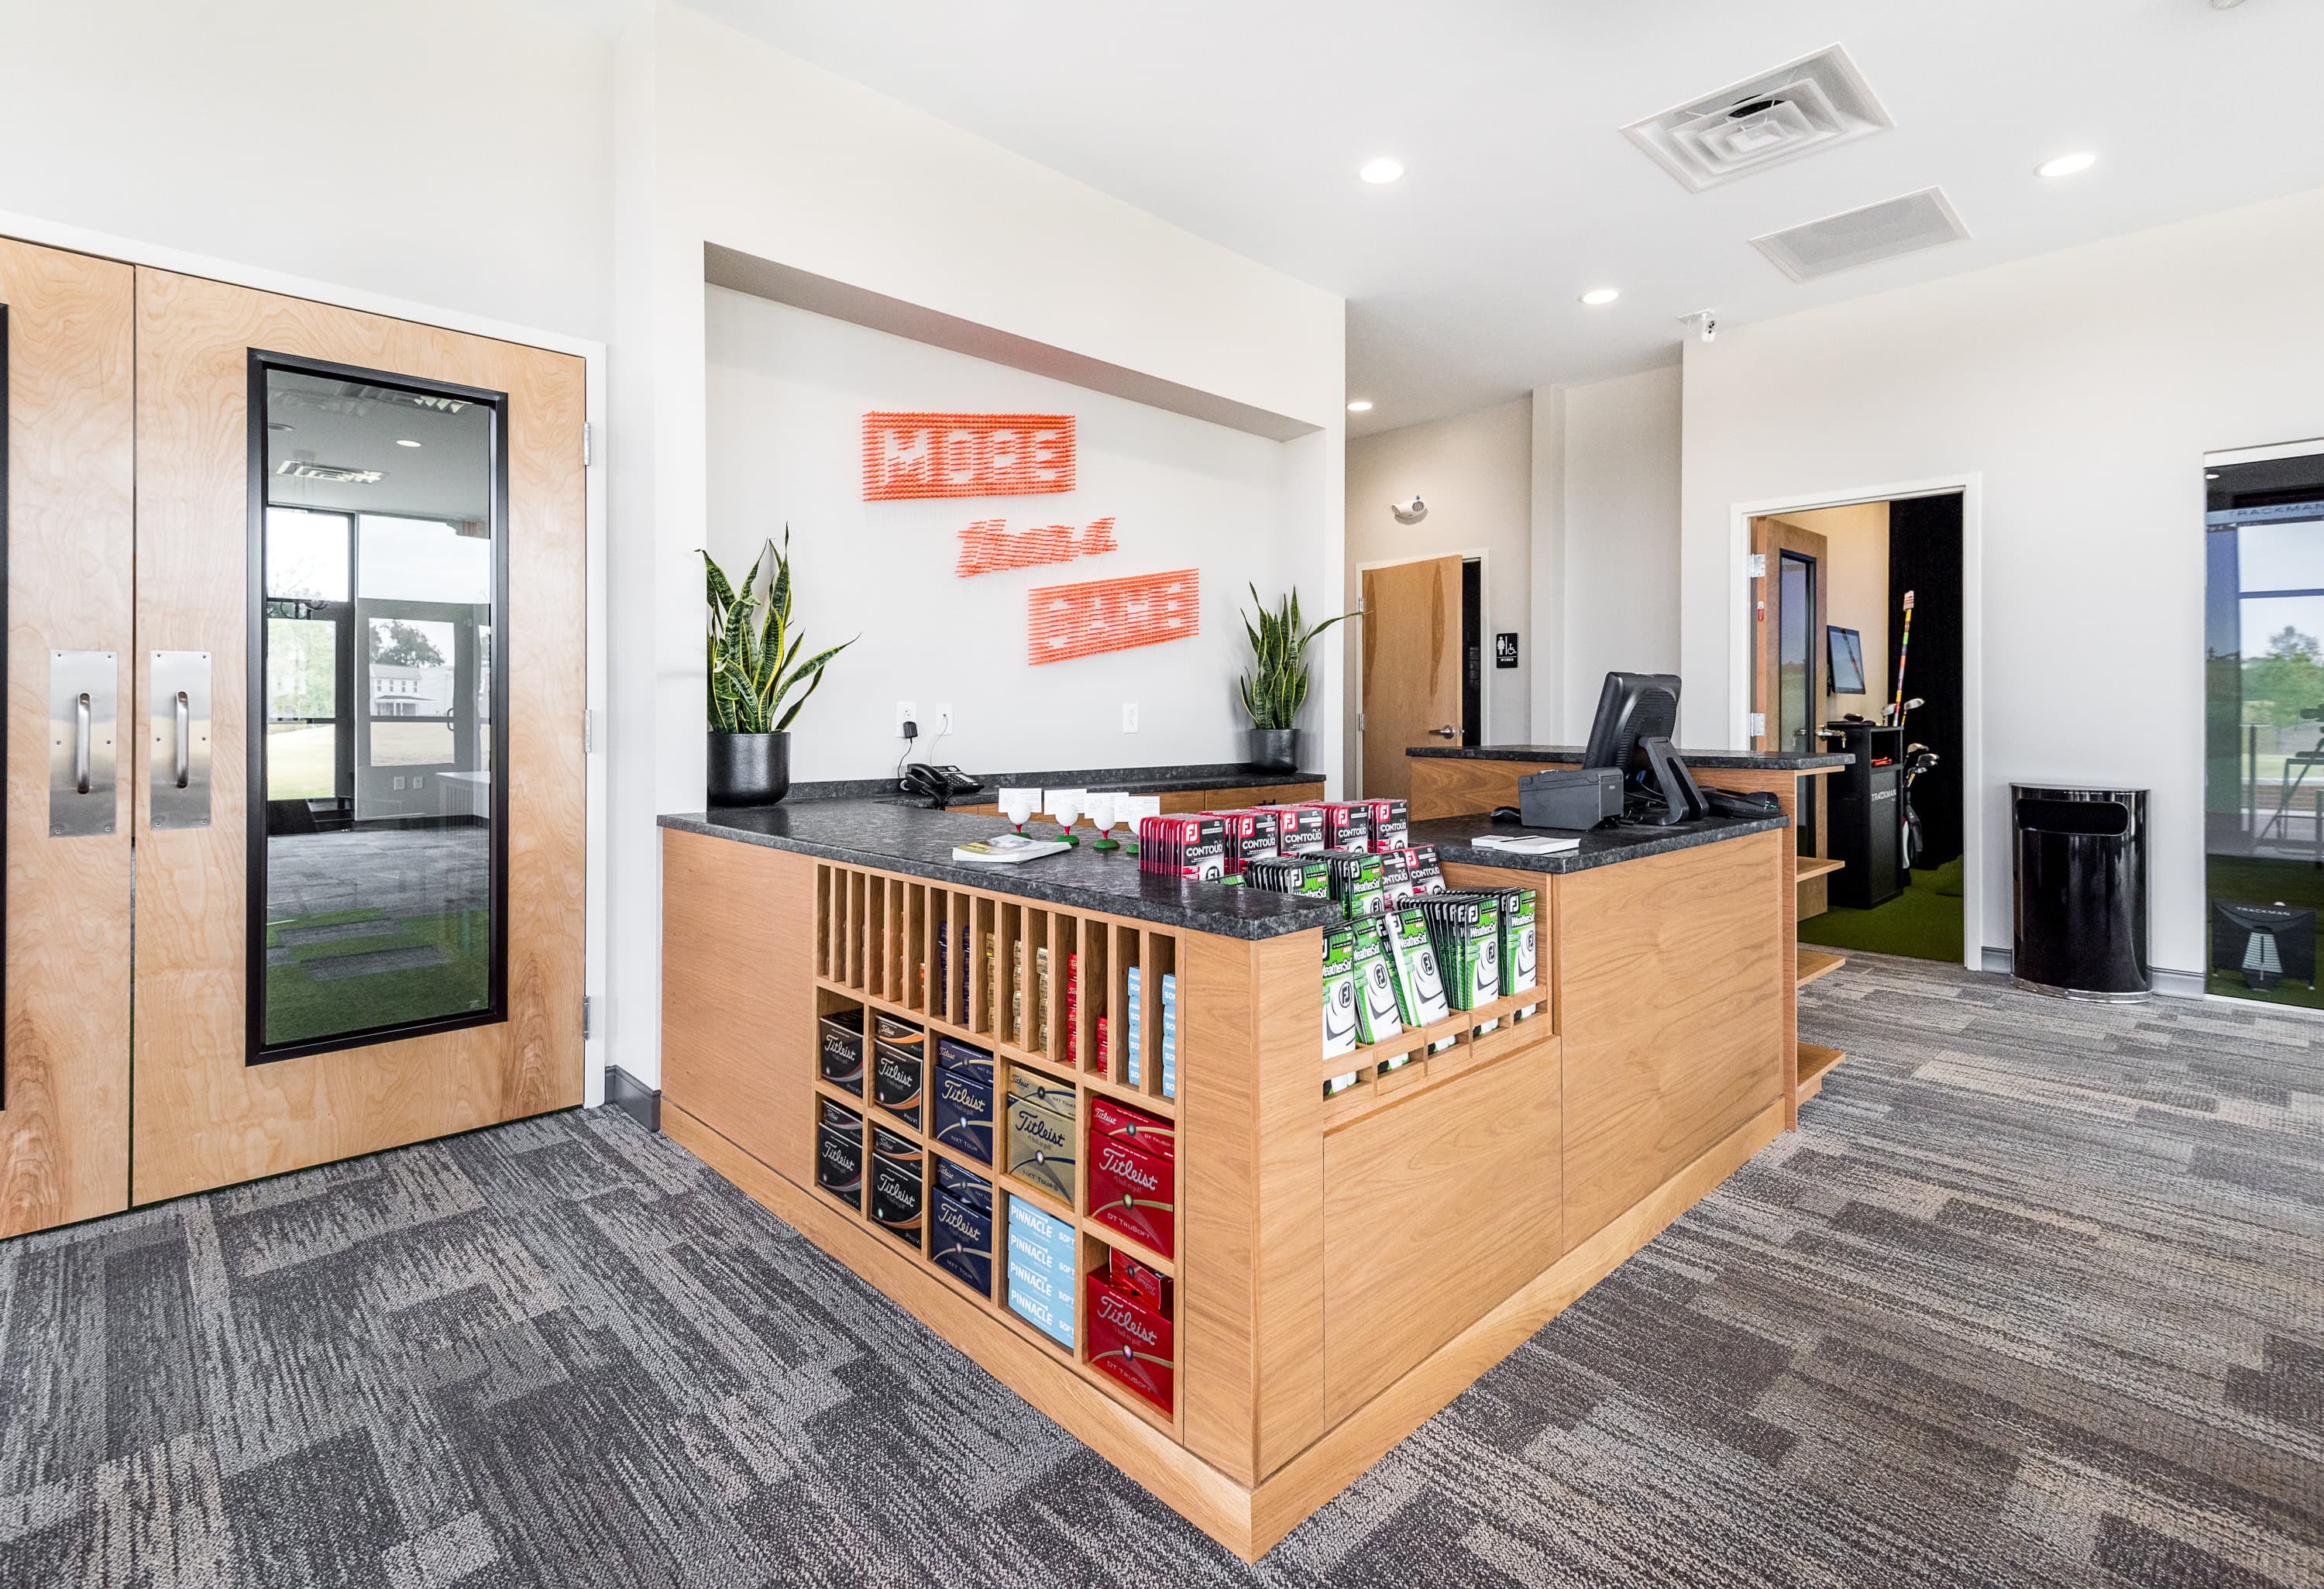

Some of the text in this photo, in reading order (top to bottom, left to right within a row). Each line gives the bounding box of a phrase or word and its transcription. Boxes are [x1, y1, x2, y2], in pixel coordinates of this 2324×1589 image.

[880, 425, 1064, 488] MORE
[1045, 582, 1186, 649] GAME
[1338, 808, 1348, 825] FJ
[1380, 804, 1389, 820] FJ
[1242, 817, 1253, 835] FJ
[1284, 813, 1296, 830] FJ
[1380, 821, 1407, 832] CONTOUR
[1186, 824, 1198, 842] FJ
[1284, 832, 1322, 844] CONTOUR
[1338, 826, 1367, 838] CONTOUR
[1185, 842, 1223, 857] CONTOUR
[1242, 837, 1276, 850] CONTOUR
[1291, 868, 1303, 887] FJ
[1350, 860, 1360, 879] FJ
[1382, 872, 1408, 884] ONTOUR
[1411, 866, 1440, 879] CONTOUR
[1510, 895, 1519, 913] FJ
[2236, 906, 2291, 917] TRACKMAN
[1468, 904, 1479, 923] FJ
[824, 1034, 856, 1061] Titleist
[939, 1047, 956, 1060] Titleist
[878, 1057, 913, 1088] Titleist
[1011, 1074, 1030, 1089] Titleist
[941, 1079, 986, 1113] Titleist
[1095, 1107, 1117, 1125] Titleist
[1015, 1109, 1066, 1147] Titleist
[822, 1140, 855, 1171] Titleist
[1098, 1147, 1158, 1191] Titleist
[876, 1173, 916, 1208] Titleist
[937, 1202, 981, 1241] Titleist
[1010, 1205, 1054, 1239] PINNACLE
[1058, 1231, 1075, 1246] SOFT
[1107, 1212, 1118, 1223] DT
[1010, 1234, 1054, 1268] PINNACLE
[1058, 1261, 1075, 1276] SOFT
[1009, 1261, 1074, 1305] PINNACLE SOFT
[1010, 1288, 1074, 1335] PINNACLE SOFT
[1097, 1295, 1158, 1347] Titleist
[1106, 1360, 1117, 1371] DT
